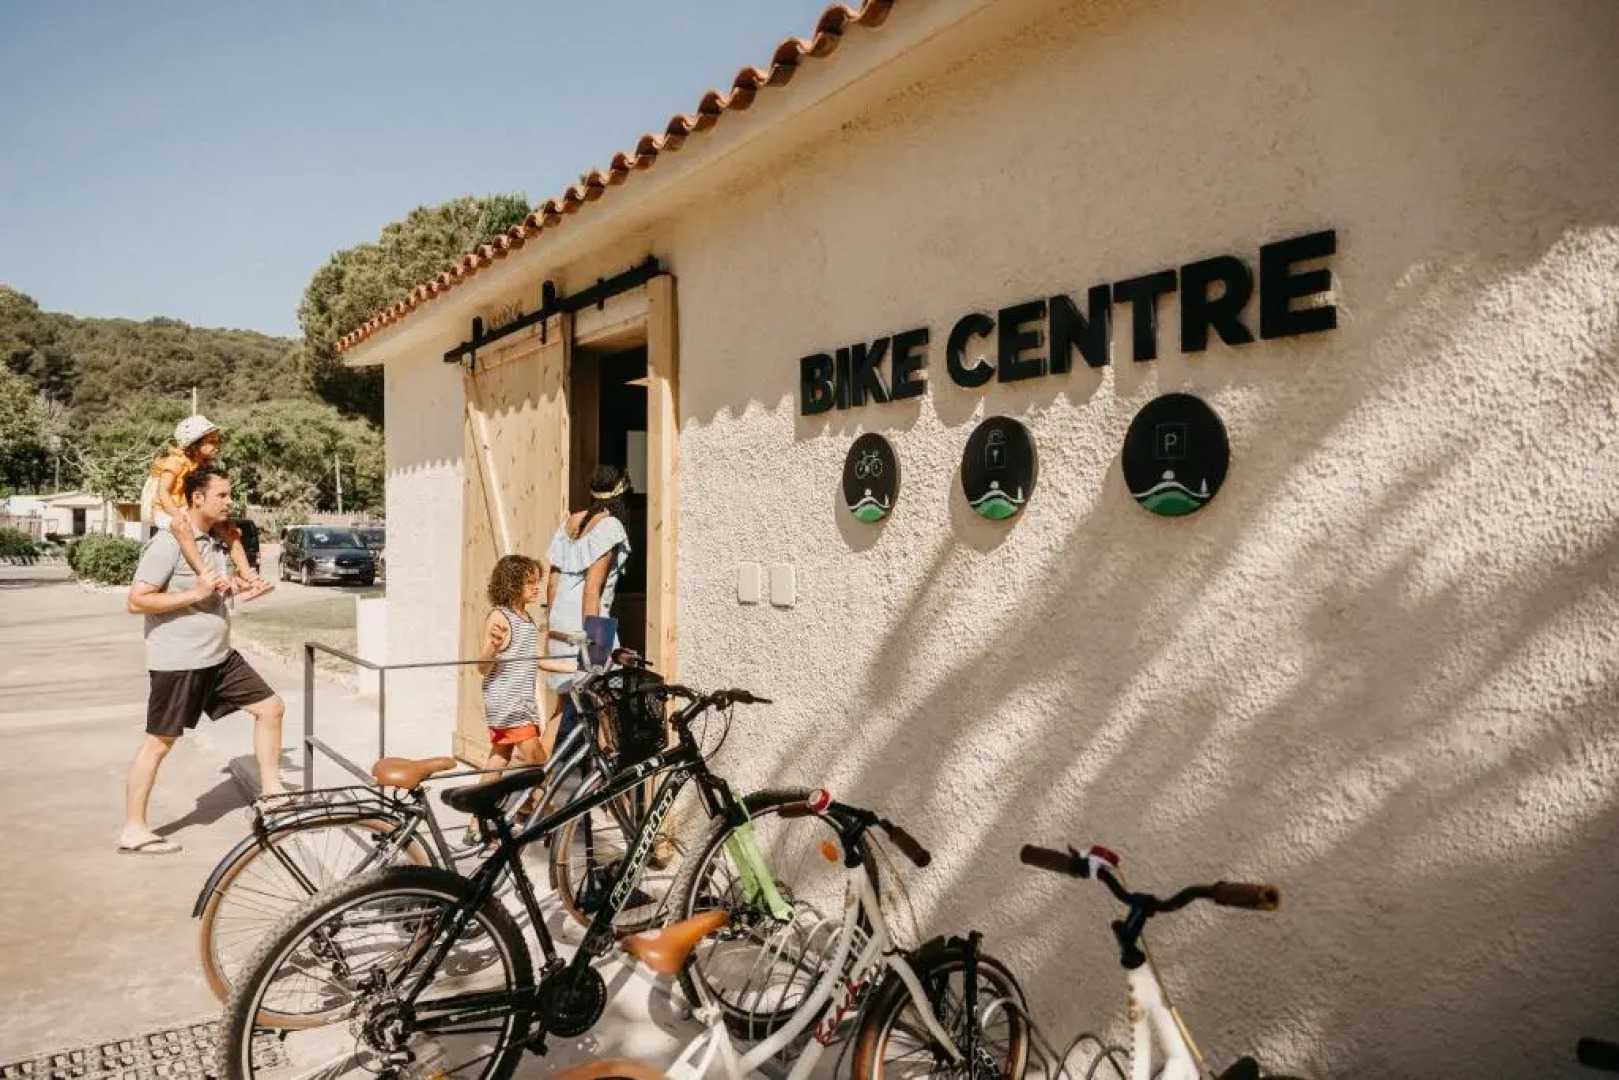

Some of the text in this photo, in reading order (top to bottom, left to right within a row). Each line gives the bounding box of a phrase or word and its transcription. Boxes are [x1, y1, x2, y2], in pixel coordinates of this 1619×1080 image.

[800, 229, 1337, 416] BIKE CENTRE
[1164, 432, 1177, 452] P
